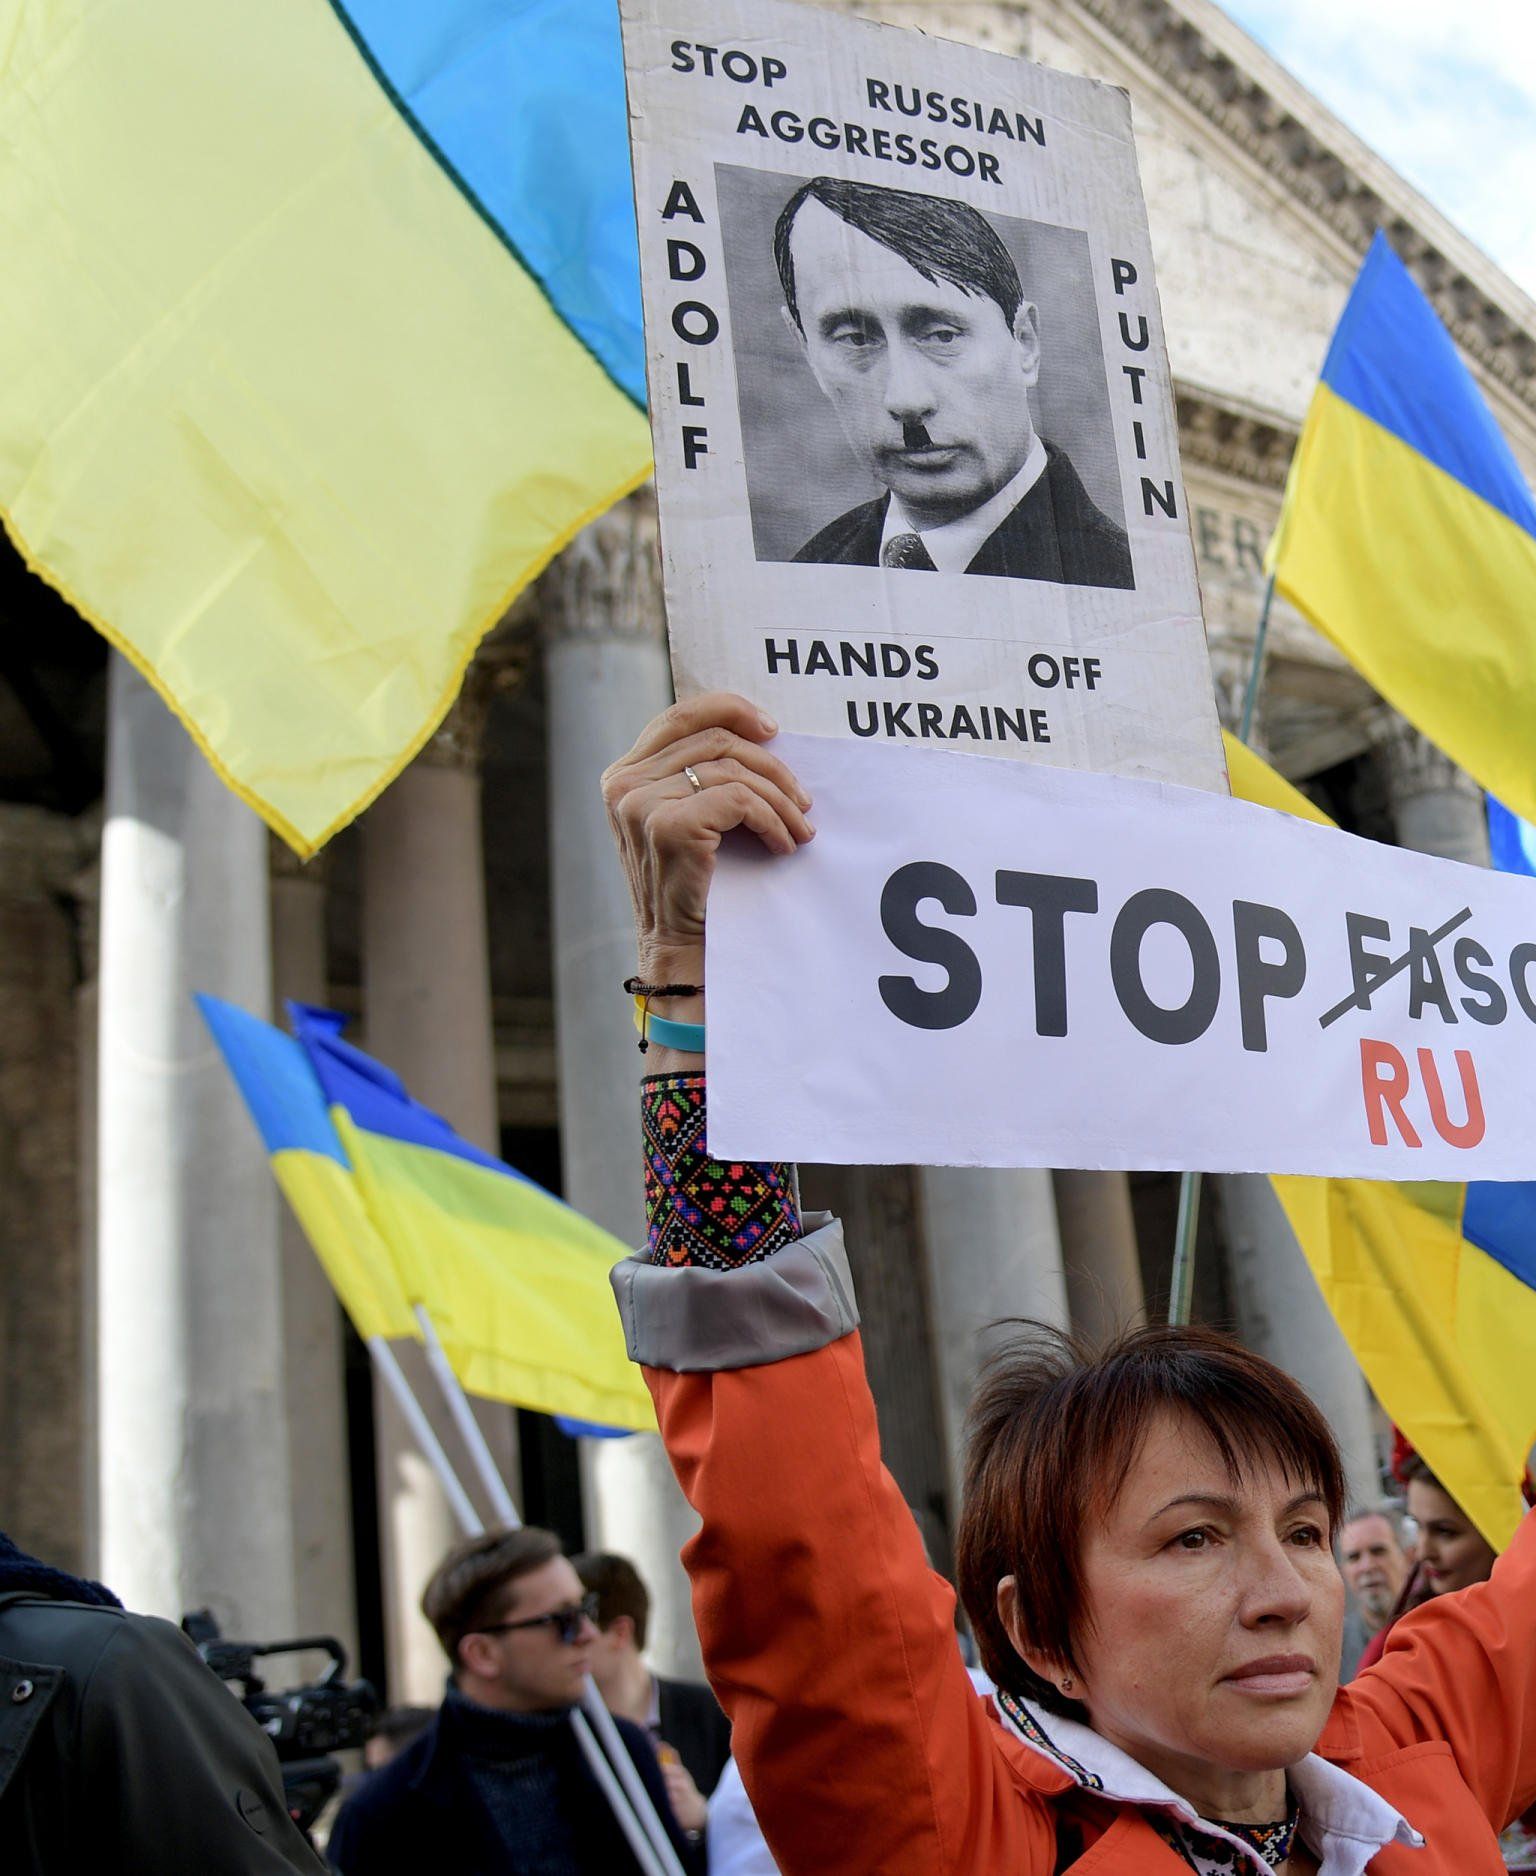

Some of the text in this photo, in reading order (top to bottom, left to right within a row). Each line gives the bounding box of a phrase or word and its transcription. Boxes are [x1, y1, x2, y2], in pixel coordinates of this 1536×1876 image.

[670, 40, 1046, 147] STOP RUSSIAN
[736, 104, 1003, 185] AGGRESSOR
[661, 180, 720, 470] ADOLF
[1110, 258, 1178, 519] PUTIN
[764, 638, 1102, 690] HANDS OFF
[846, 700, 1051, 744] UKRAINE
[878, 861, 1307, 1053] STOP
[1360, 1039, 1486, 1149] RU
